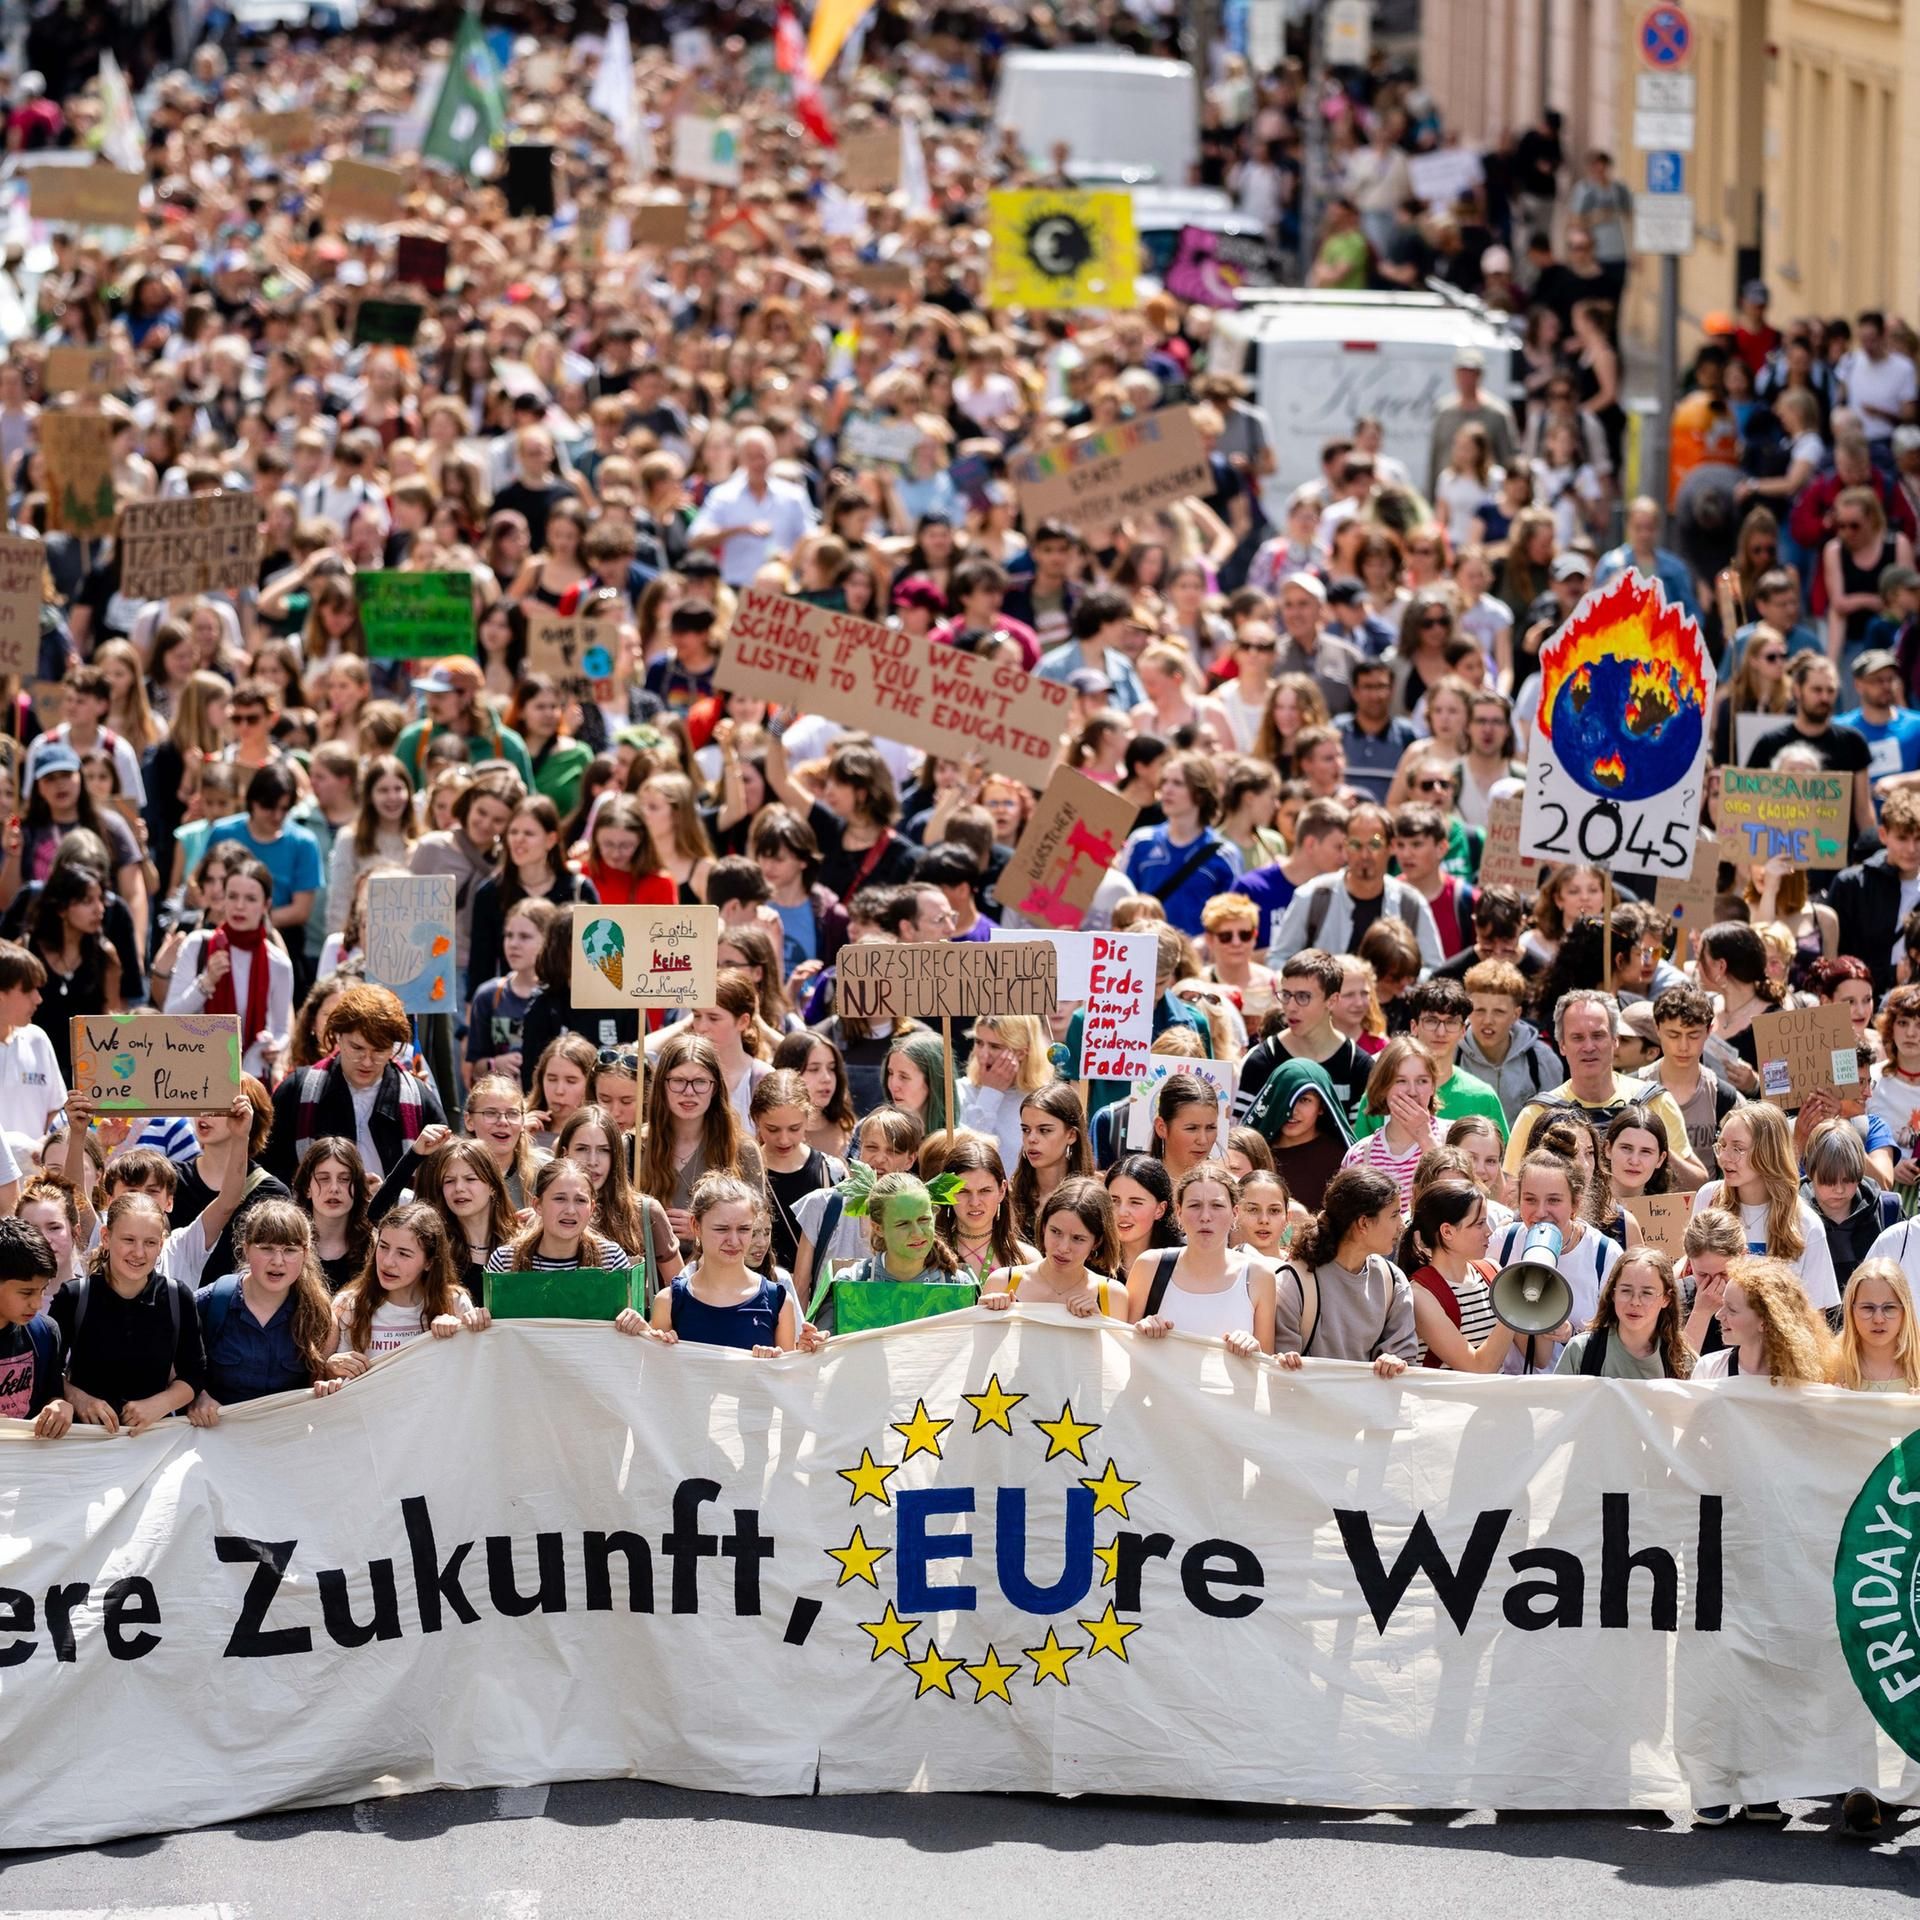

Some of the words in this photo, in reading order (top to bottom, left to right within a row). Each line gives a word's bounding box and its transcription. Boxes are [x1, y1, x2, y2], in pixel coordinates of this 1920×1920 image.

[747, 591, 811, 626] WHY
[825, 615, 911, 659] SHOULD
[928, 645, 976, 678] WE
[993, 666, 1029, 694] GO
[1039, 680, 1068, 705] TO
[731, 613, 821, 658] SCHOOL
[834, 641, 859, 666] IF
[871, 653, 920, 690] YOU
[932, 674, 1014, 718] WON'T
[735, 643, 819, 684] LISTEN
[829, 667, 857, 693] TO
[874, 683, 924, 719] THE
[931, 703, 1052, 760] EDUCATED
[1724, 768, 1843, 801] DINOSAURS
[1532, 799, 1691, 869] 2045
[1742, 823, 1810, 863] TIME
[369, 879, 452, 908] FISCHERS
[649, 921, 664, 937] Es
[667, 920, 694, 947] gibt
[652, 948, 692, 970] keine
[841, 946, 1058, 979] KURZSTRECKENFLÜGE
[1092, 937, 1129, 962] Die
[635, 973, 654, 994] 2.
[1089, 964, 1143, 995] Erde
[843, 979, 897, 1017] NUR
[904, 977, 951, 1017] FÜR
[959, 977, 1058, 1017] INSEKTEN
[1087, 995, 1140, 1023] hängt
[1088, 1017, 1116, 1030] am
[1778, 1011, 1824, 1036] OUR
[86, 1025, 120, 1052] We
[128, 1032, 154, 1057] only
[166, 1032, 205, 1053] have
[1767, 1028, 1841, 1059] FUTURE
[1083, 1051, 1148, 1077] Faden
[1797, 1055, 1816, 1071] IN
[91, 1084, 132, 1098] one
[154, 1068, 209, 1100] Planet
[1790, 1069, 1834, 1089] YOUR
[1649, 1200, 1671, 1217] hier,
[215, 1478, 823, 1658] Zukunft,
[896, 1486, 1265, 1618] EUre
[1333, 1492, 1723, 1636] Wahl
